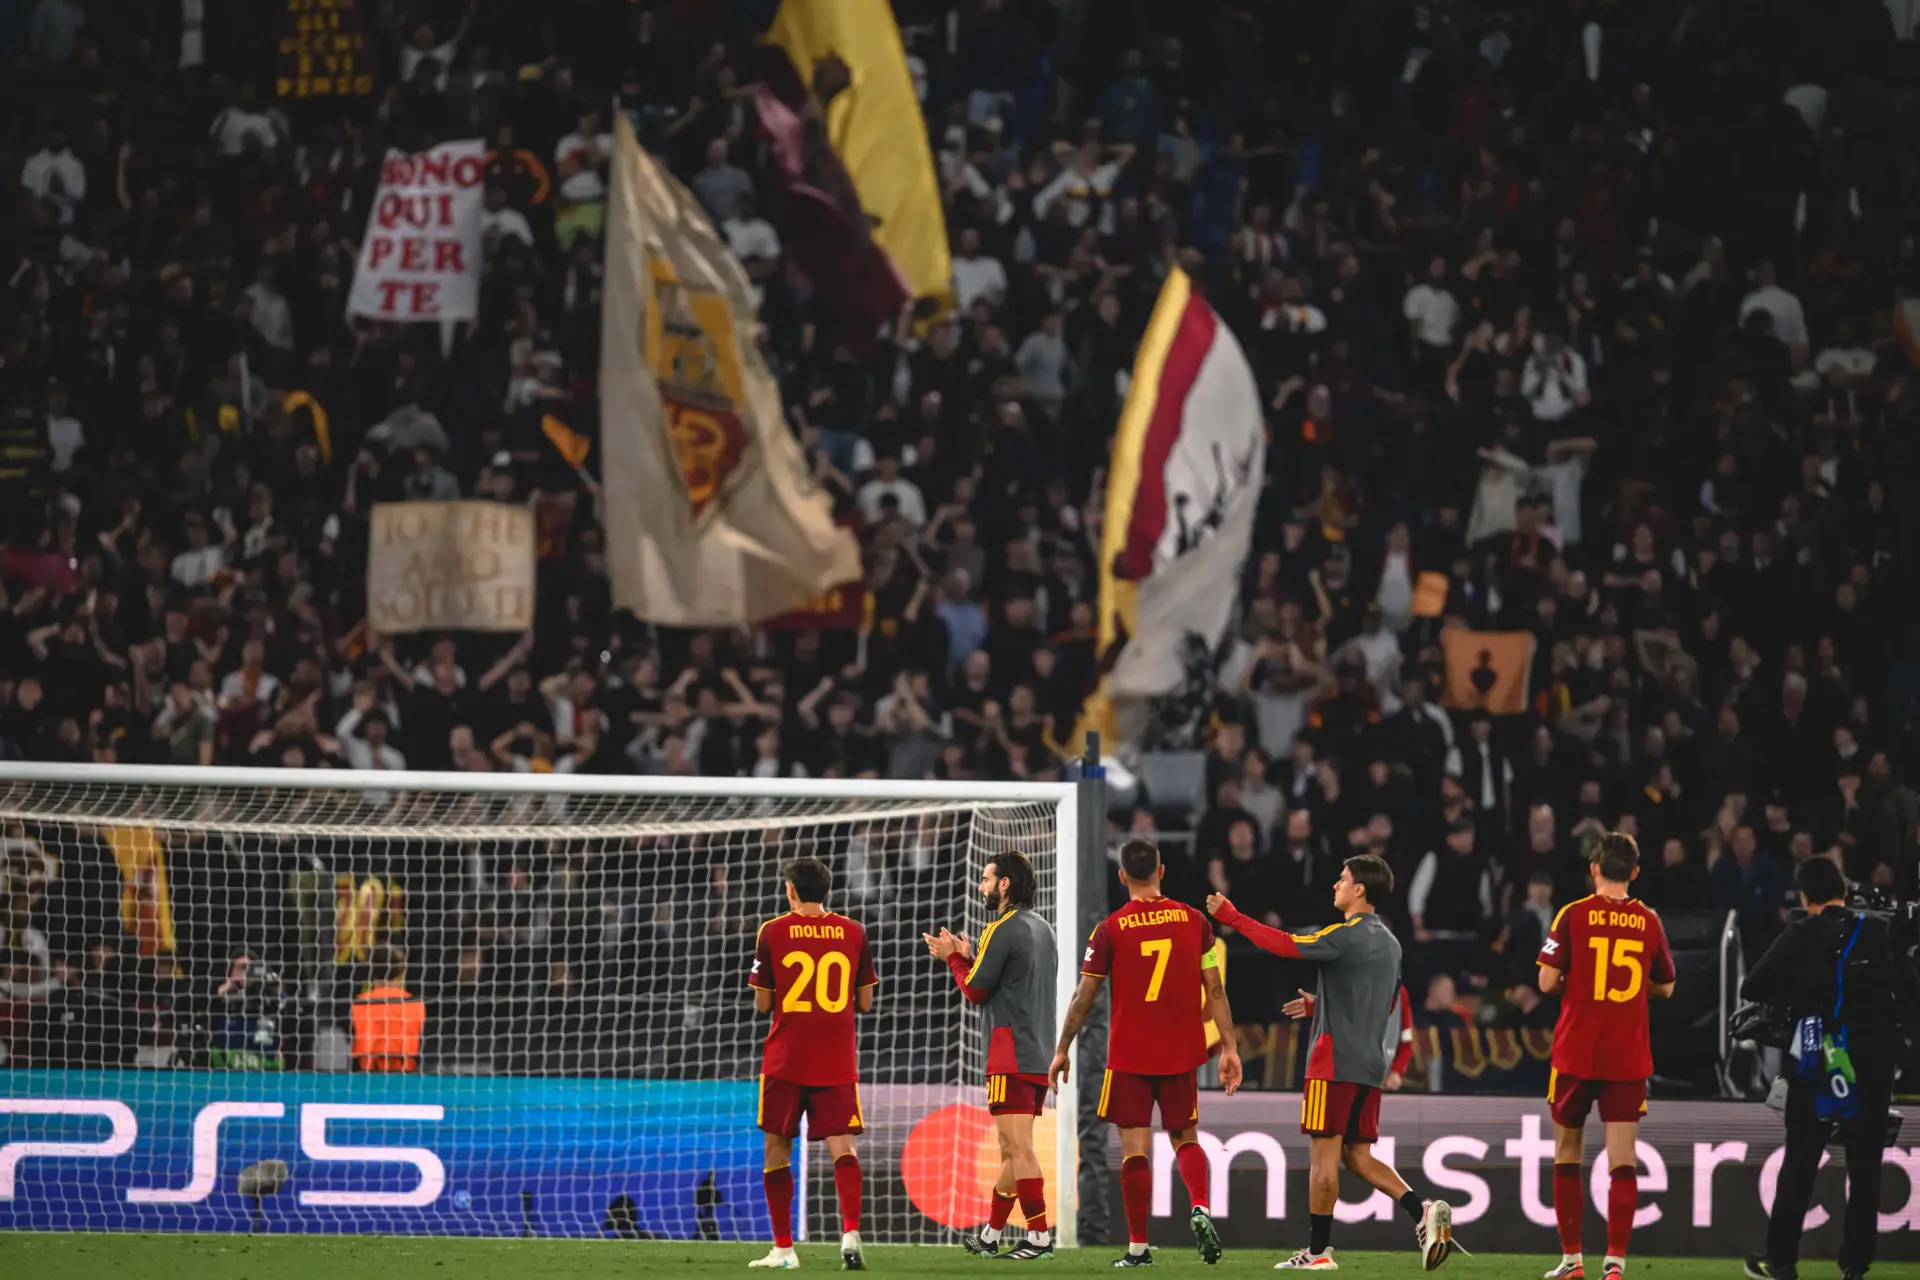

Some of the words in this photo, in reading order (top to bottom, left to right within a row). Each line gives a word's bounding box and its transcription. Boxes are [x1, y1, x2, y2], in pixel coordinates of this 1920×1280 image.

[377, 193, 453, 228] QUI
[368, 237, 465, 273] PER
[377, 279, 441, 313] TE
[789, 925, 845, 940] MOLINA
[1119, 909, 1189, 931] PELLEGRINI
[1588, 909, 1606, 926] DE
[1609, 911, 1647, 932] ROON
[781, 951, 851, 1013] 20
[1140, 938, 1173, 1002] 7
[1588, 937, 1645, 1003] 15
[0, 1098, 446, 1207] PS5
